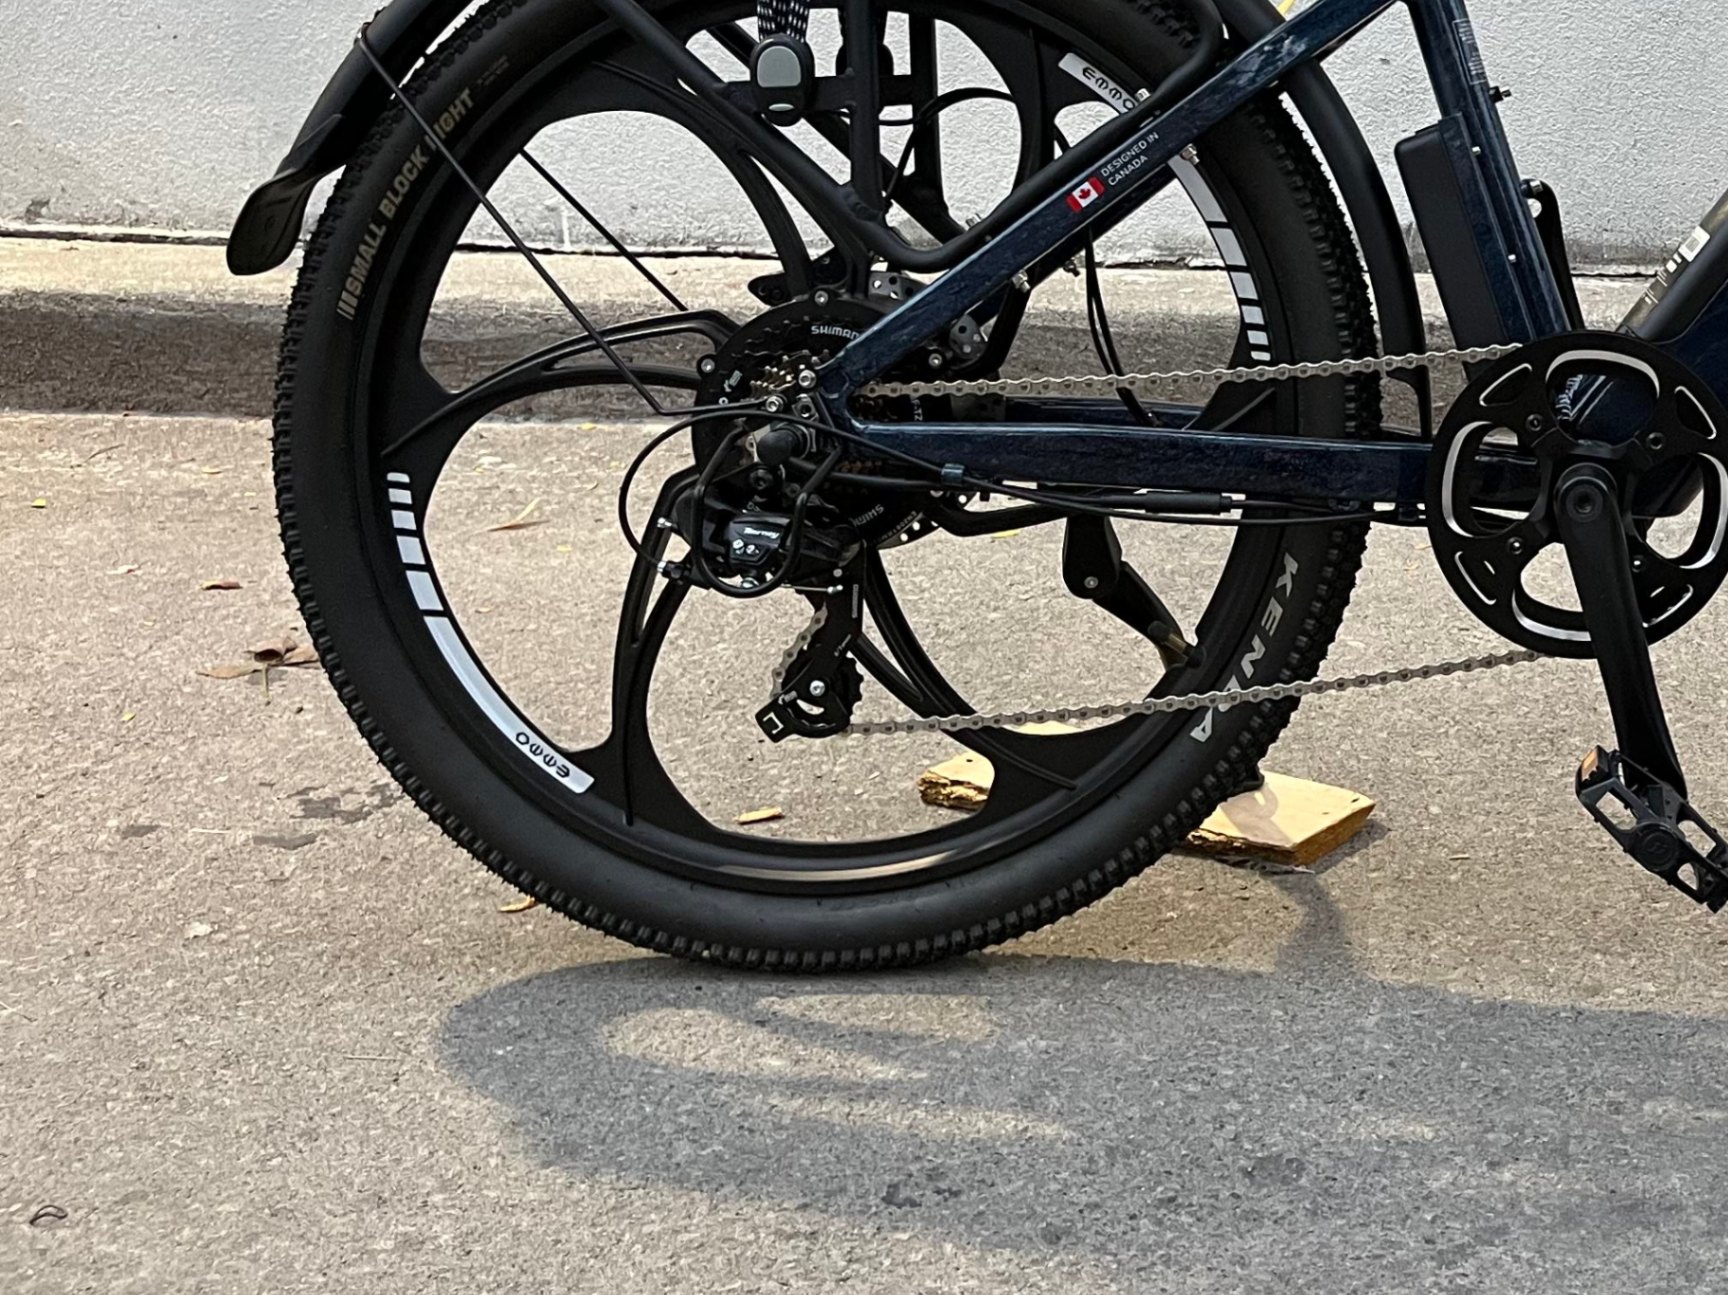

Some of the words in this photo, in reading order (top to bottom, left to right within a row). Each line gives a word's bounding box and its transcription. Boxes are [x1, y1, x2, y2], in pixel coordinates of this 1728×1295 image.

[1082, 66, 1136, 111] EMMO
[1101, 140, 1147, 177] DESIGNED
[1147, 132, 1159, 143] IN
[1108, 155, 1148, 186] CANADA
[345, 219, 386, 296] SMALL
[379, 144, 430, 220] BLOCK
[811, 325, 862, 340] SHIMAN
[516, 732, 570, 778] EMMO
